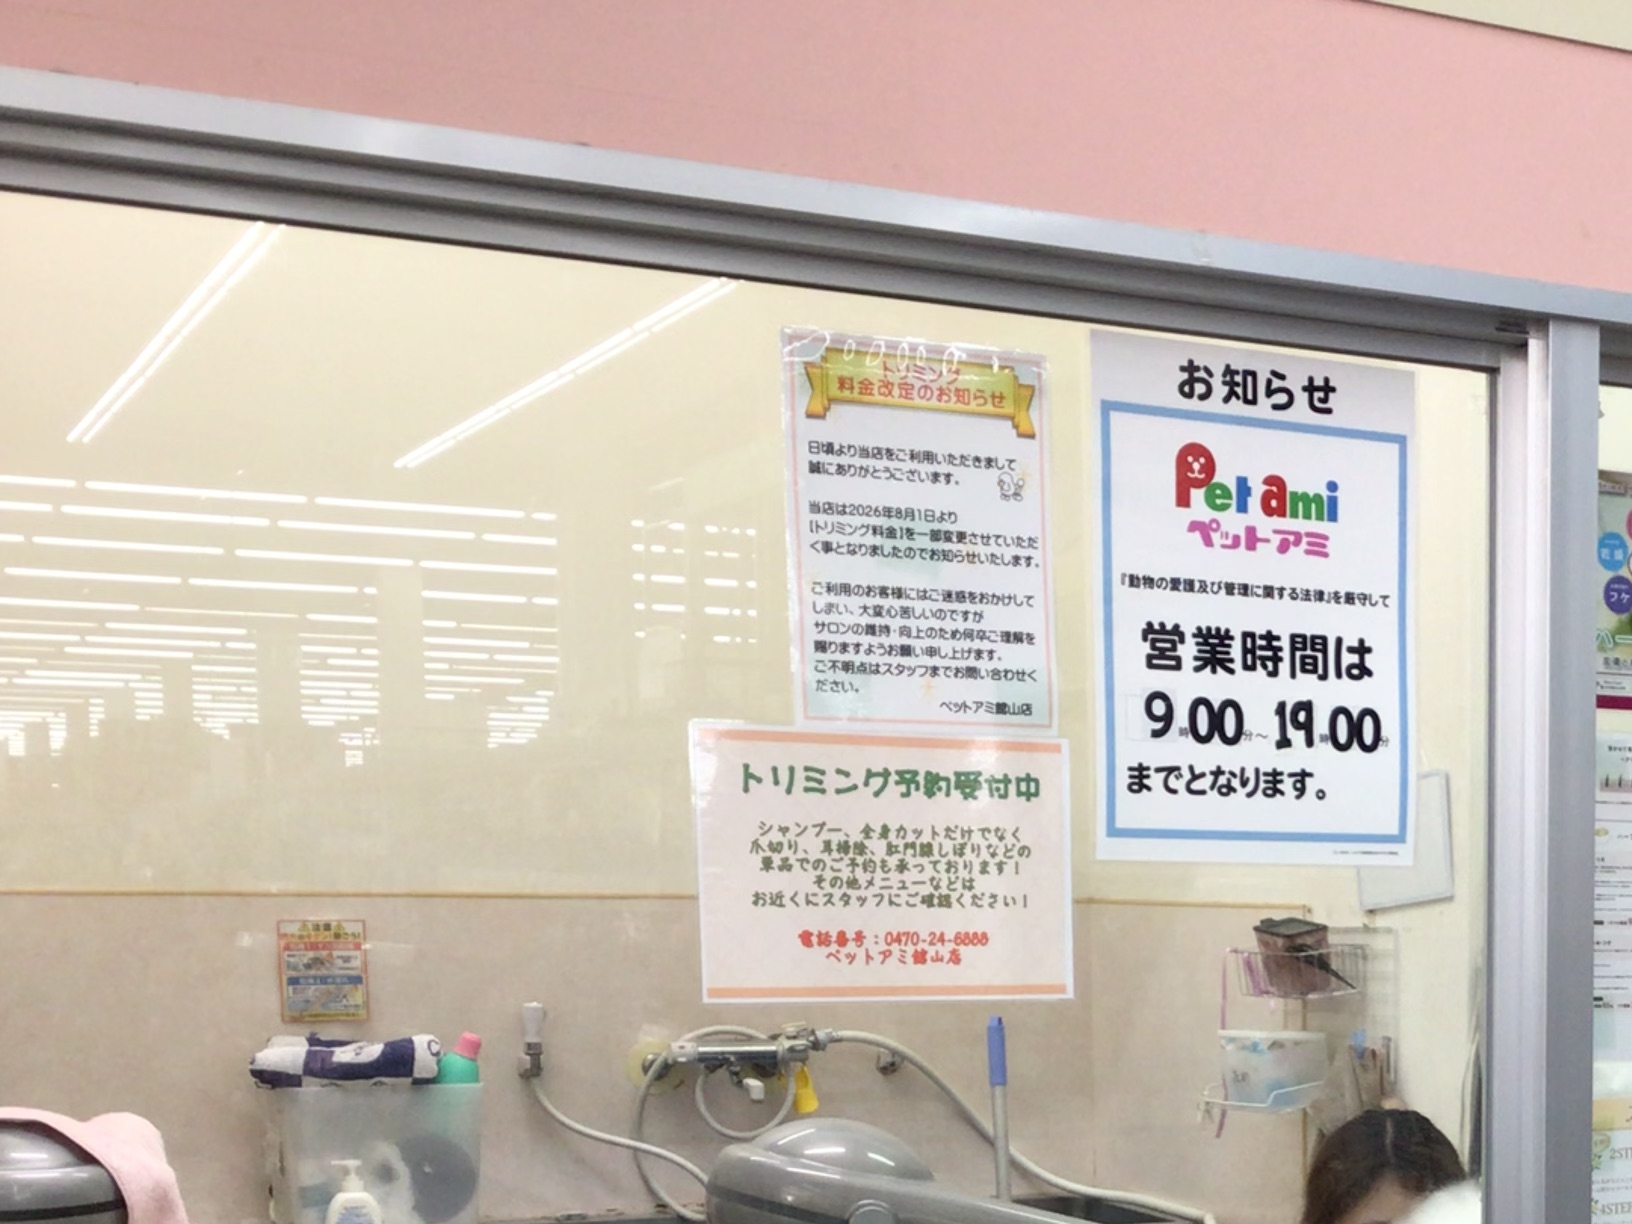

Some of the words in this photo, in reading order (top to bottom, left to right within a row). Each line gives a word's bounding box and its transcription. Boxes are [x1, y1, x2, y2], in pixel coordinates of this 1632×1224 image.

[836, 374, 1006, 409] 料金改定のお知らせ
[1177, 358, 1338, 416] お知らせ
[808, 439, 1017, 472] 日頃より当店をご利用いただきまして
[808, 459, 961, 487] 誠にありがとうございます。
[1174, 441, 1252, 514] Pet
[1259, 472, 1339, 523] ami
[808, 500, 959, 526] 当店は2026年8月1日より
[1186, 518, 1331, 559] ペットアミ
[809, 540, 1041, 569] く事となりましたのでお知らせいたします。
[811, 580, 1035, 609] ご利用のお客様にはご迷惑をおかけして
[812, 601, 984, 623] しまい、大変心苦しいのですが
[813, 639, 1003, 662] 賜りますようお願い申し上げます。
[1140, 620, 1375, 682] 営業時間は
[814, 659, 1038, 683] ご不明点はスタッフまでお問い合わせく
[815, 678, 861, 695] ださい。
[939, 699, 1033, 717] ペットアミ館山店
[741, 762, 1042, 803] トリミング予約受付中
[1126, 761, 1328, 802] までとなります。
[756, 820, 1022, 844] シャンプー、全身カットだけでなく
[811, 873, 976, 893] その他メニューなどは
[824, 946, 963, 967] ペットアミ館山店
